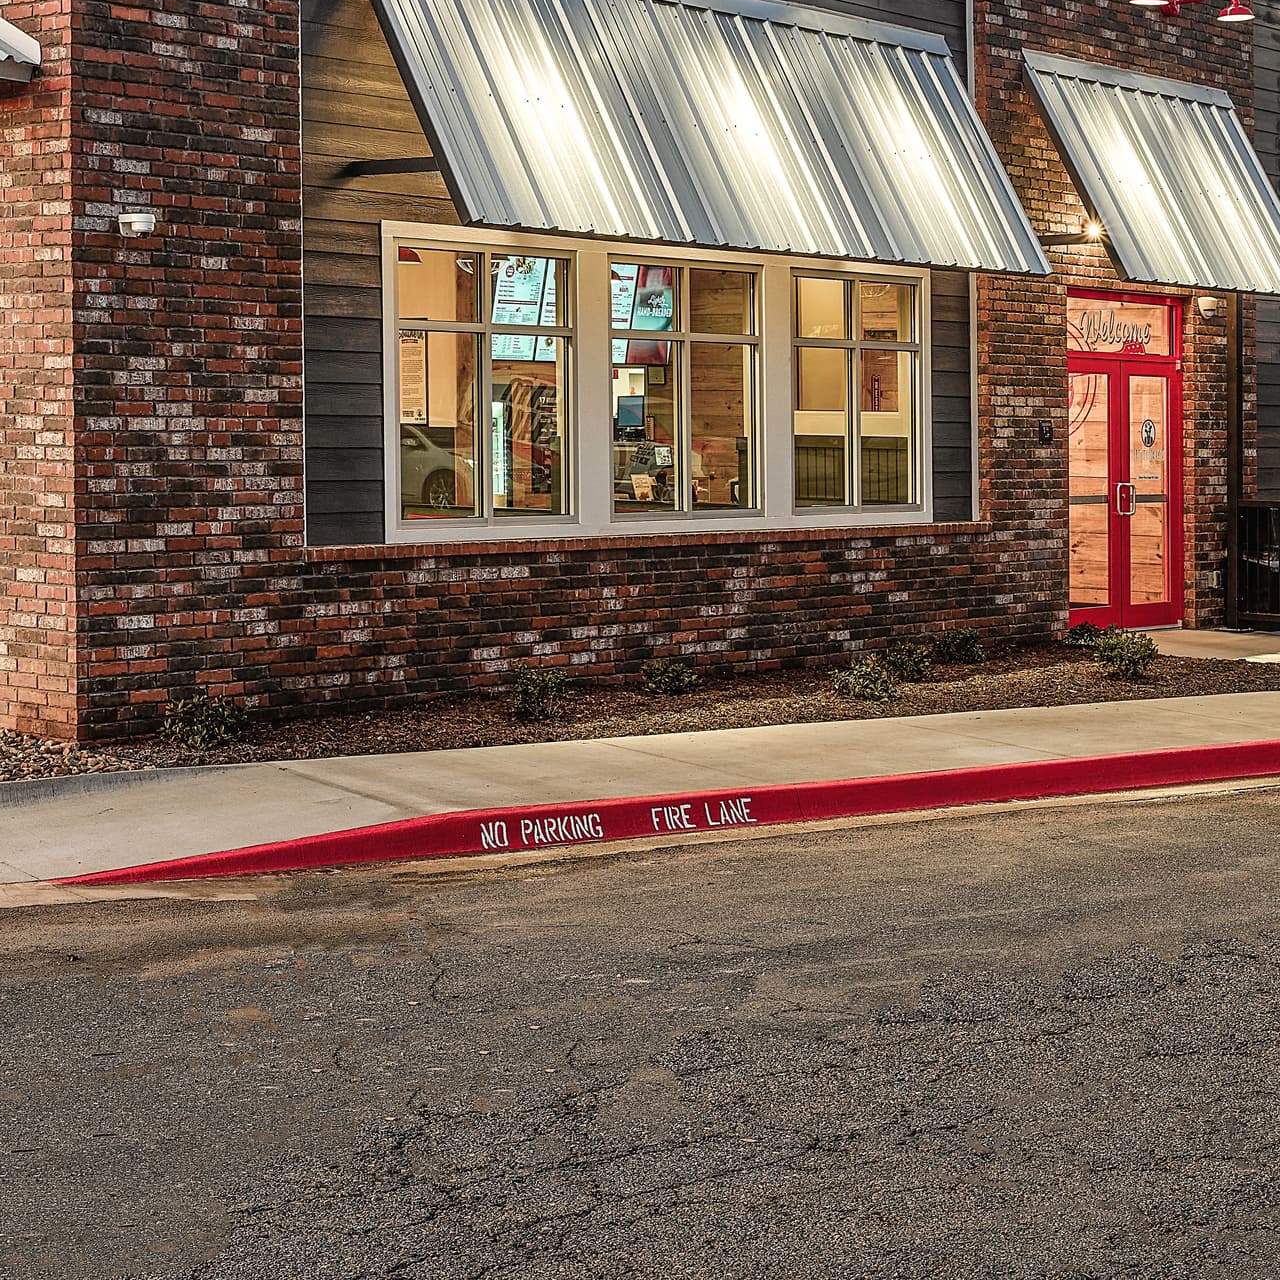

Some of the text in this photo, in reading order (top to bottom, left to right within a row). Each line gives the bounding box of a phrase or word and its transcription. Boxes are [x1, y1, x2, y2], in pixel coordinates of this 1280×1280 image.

[1080, 310, 1151, 345] Welcome
[480, 798, 758, 849] NO PARKING FIRE LANE
